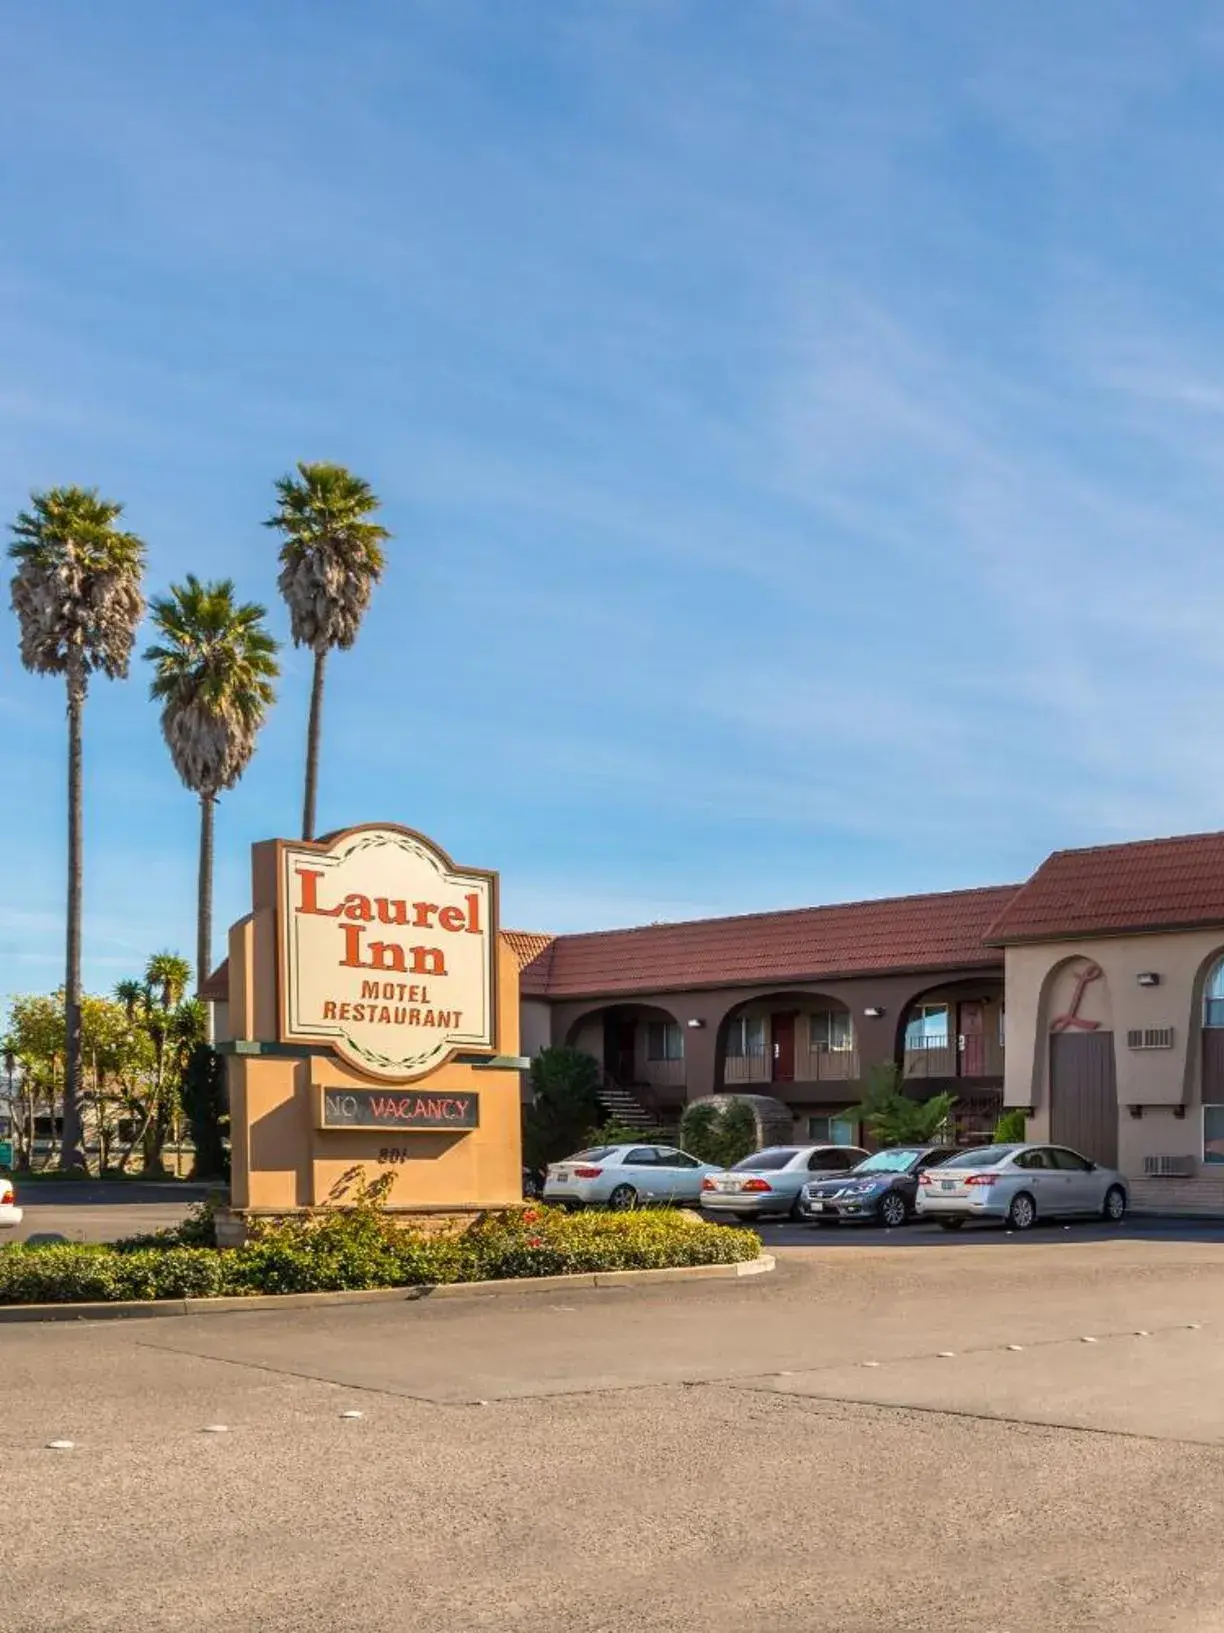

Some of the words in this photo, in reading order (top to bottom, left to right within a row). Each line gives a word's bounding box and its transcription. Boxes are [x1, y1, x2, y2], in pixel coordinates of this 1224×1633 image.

[294, 868, 484, 934] Laurel
[338, 923, 448, 976] Inn
[361, 980, 432, 1004] MOTEL
[322, 1001, 463, 1029] RESTAURANT
[325, 1095, 358, 1117] NO
[369, 1096, 469, 1121] VACANCY
